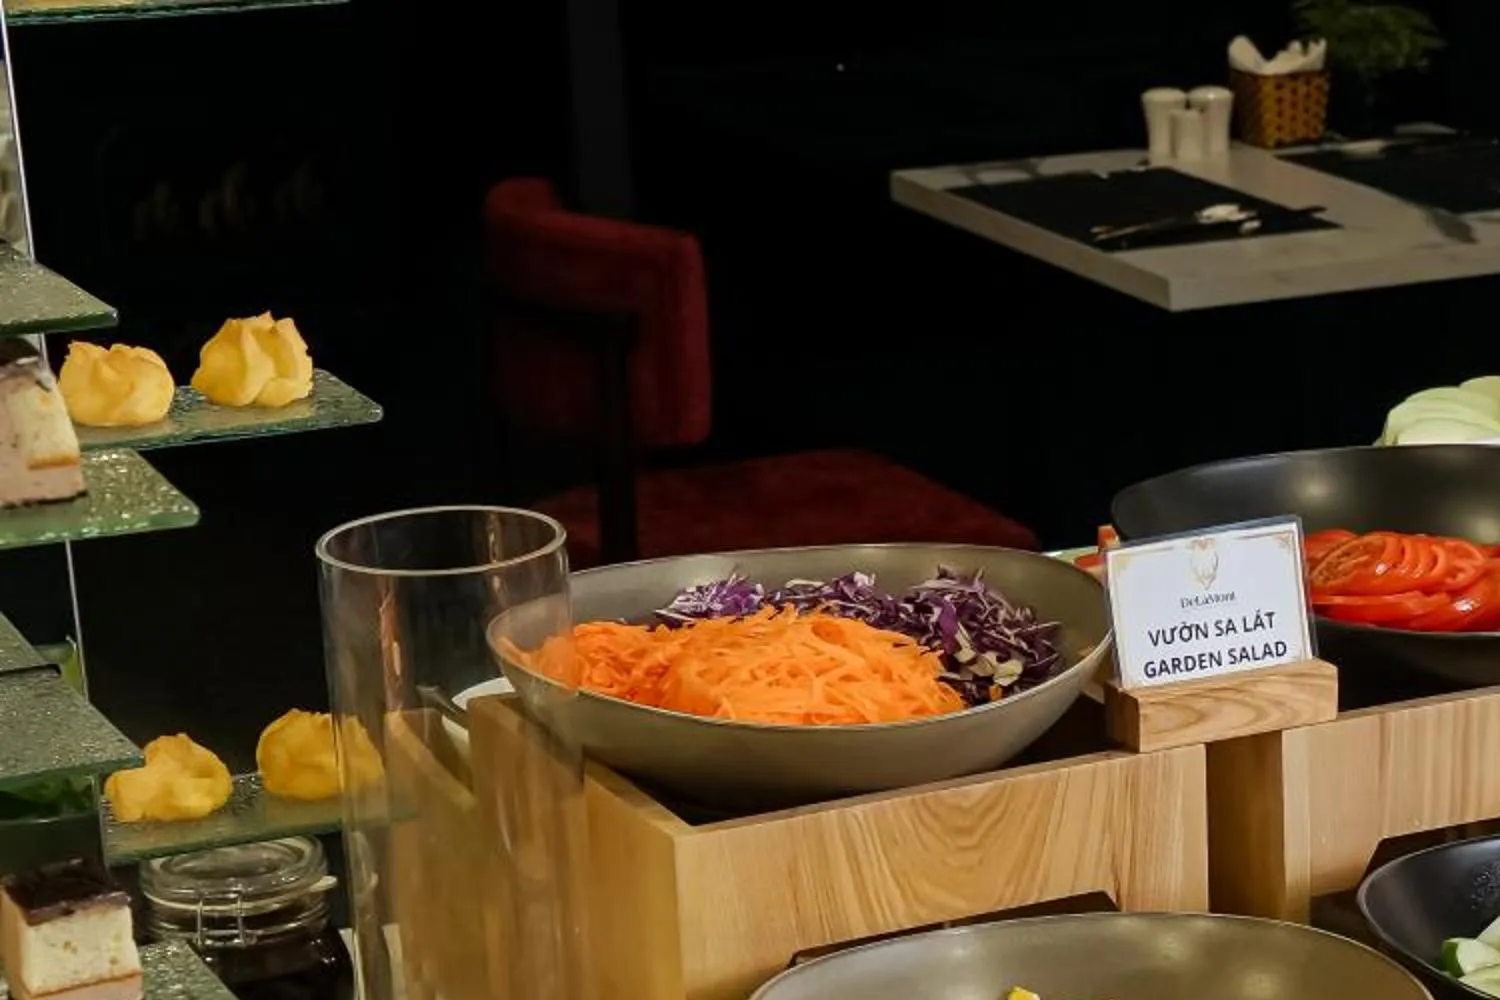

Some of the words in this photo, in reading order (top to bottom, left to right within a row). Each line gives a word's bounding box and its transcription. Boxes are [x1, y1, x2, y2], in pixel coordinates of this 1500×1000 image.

[1148, 621, 1209, 647] VƯỜN
[1215, 618, 1238, 637] SA
[1143, 651, 1223, 679] GARDEN
[1229, 641, 1288, 665] SALAD
